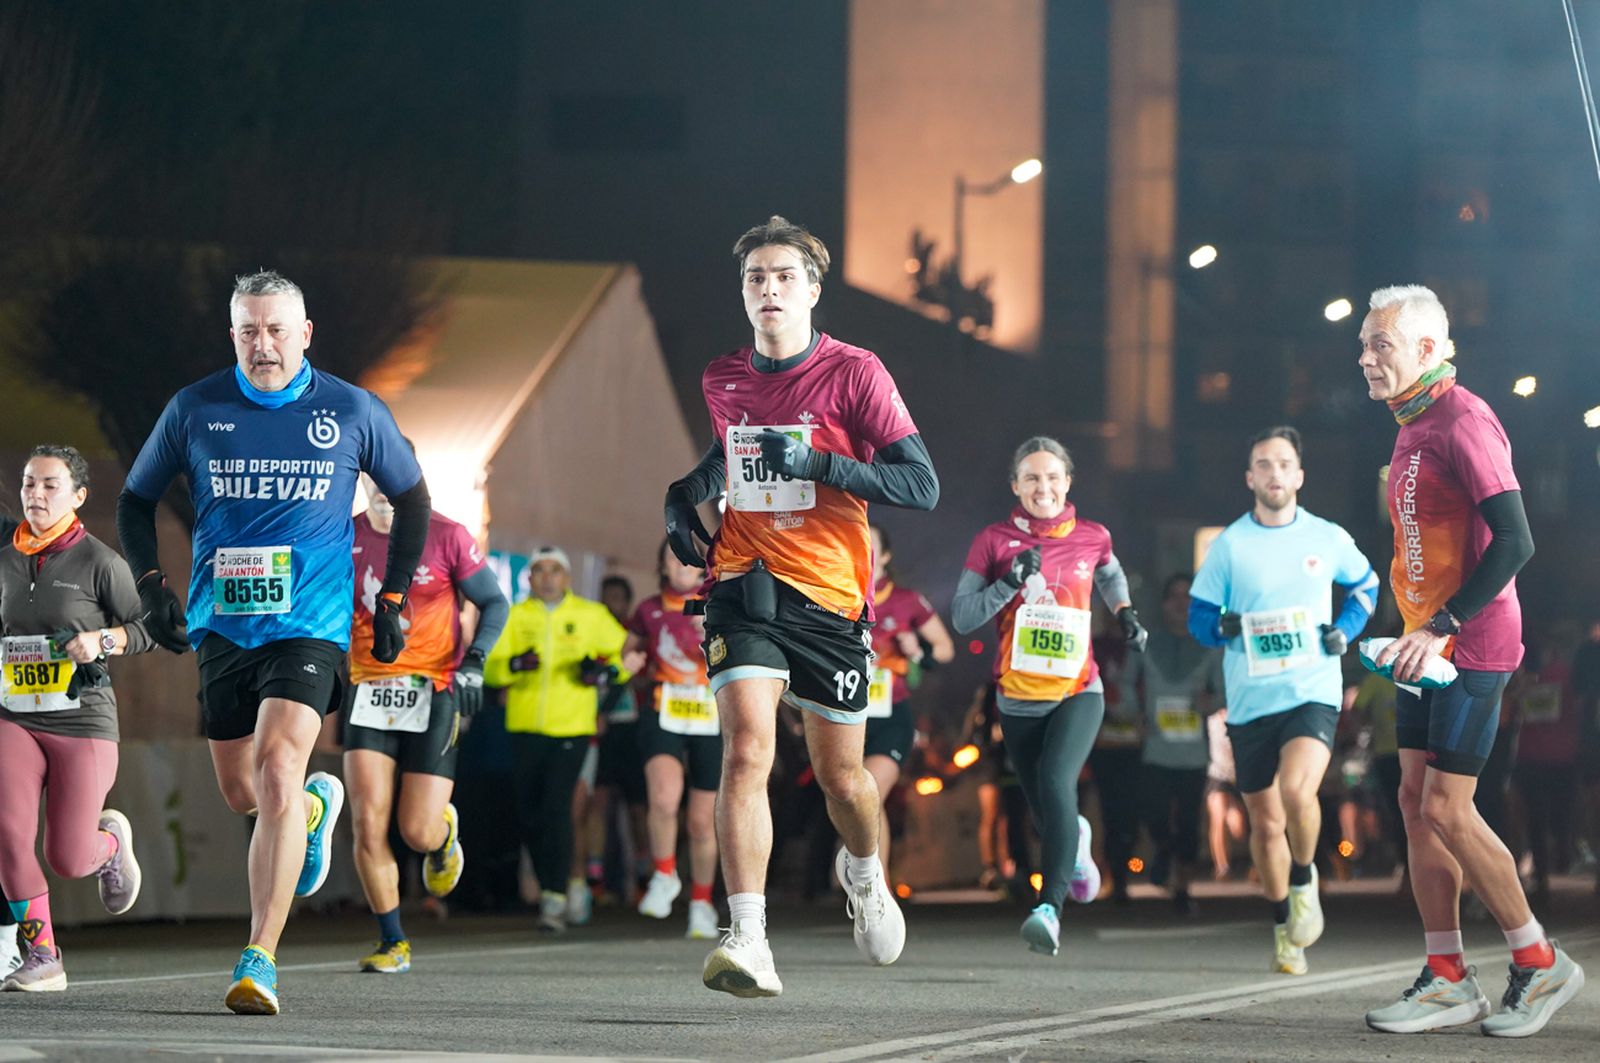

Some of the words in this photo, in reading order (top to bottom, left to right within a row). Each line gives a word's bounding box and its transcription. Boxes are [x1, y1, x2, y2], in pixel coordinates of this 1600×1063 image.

[208, 421, 235, 431] vive
[734, 446, 748, 455] SAN
[209, 459, 245, 473] CLUB
[249, 459, 335, 475] DEPORTIVO
[741, 457, 793, 482] 50
[210, 476, 331, 501] BULEVAR
[1403, 450, 1424, 582] TORREPEROGIL
[219, 567, 234, 577] SAN
[234, 565, 264, 576] ANTÓN
[228, 557, 252, 566] NOCHE
[253, 556, 263, 565] DE
[224, 578, 284, 604] 8555
[14, 644, 33, 653] NOCHE
[1030, 629, 1074, 653] 1595
[1260, 632, 1302, 653] 3931
[8, 654, 20, 663] SAN
[20, 652, 43, 662] ANTÓN
[13, 662, 60, 687] 5687
[833, 669, 860, 701] 19
[370, 688, 418, 708] 5659
